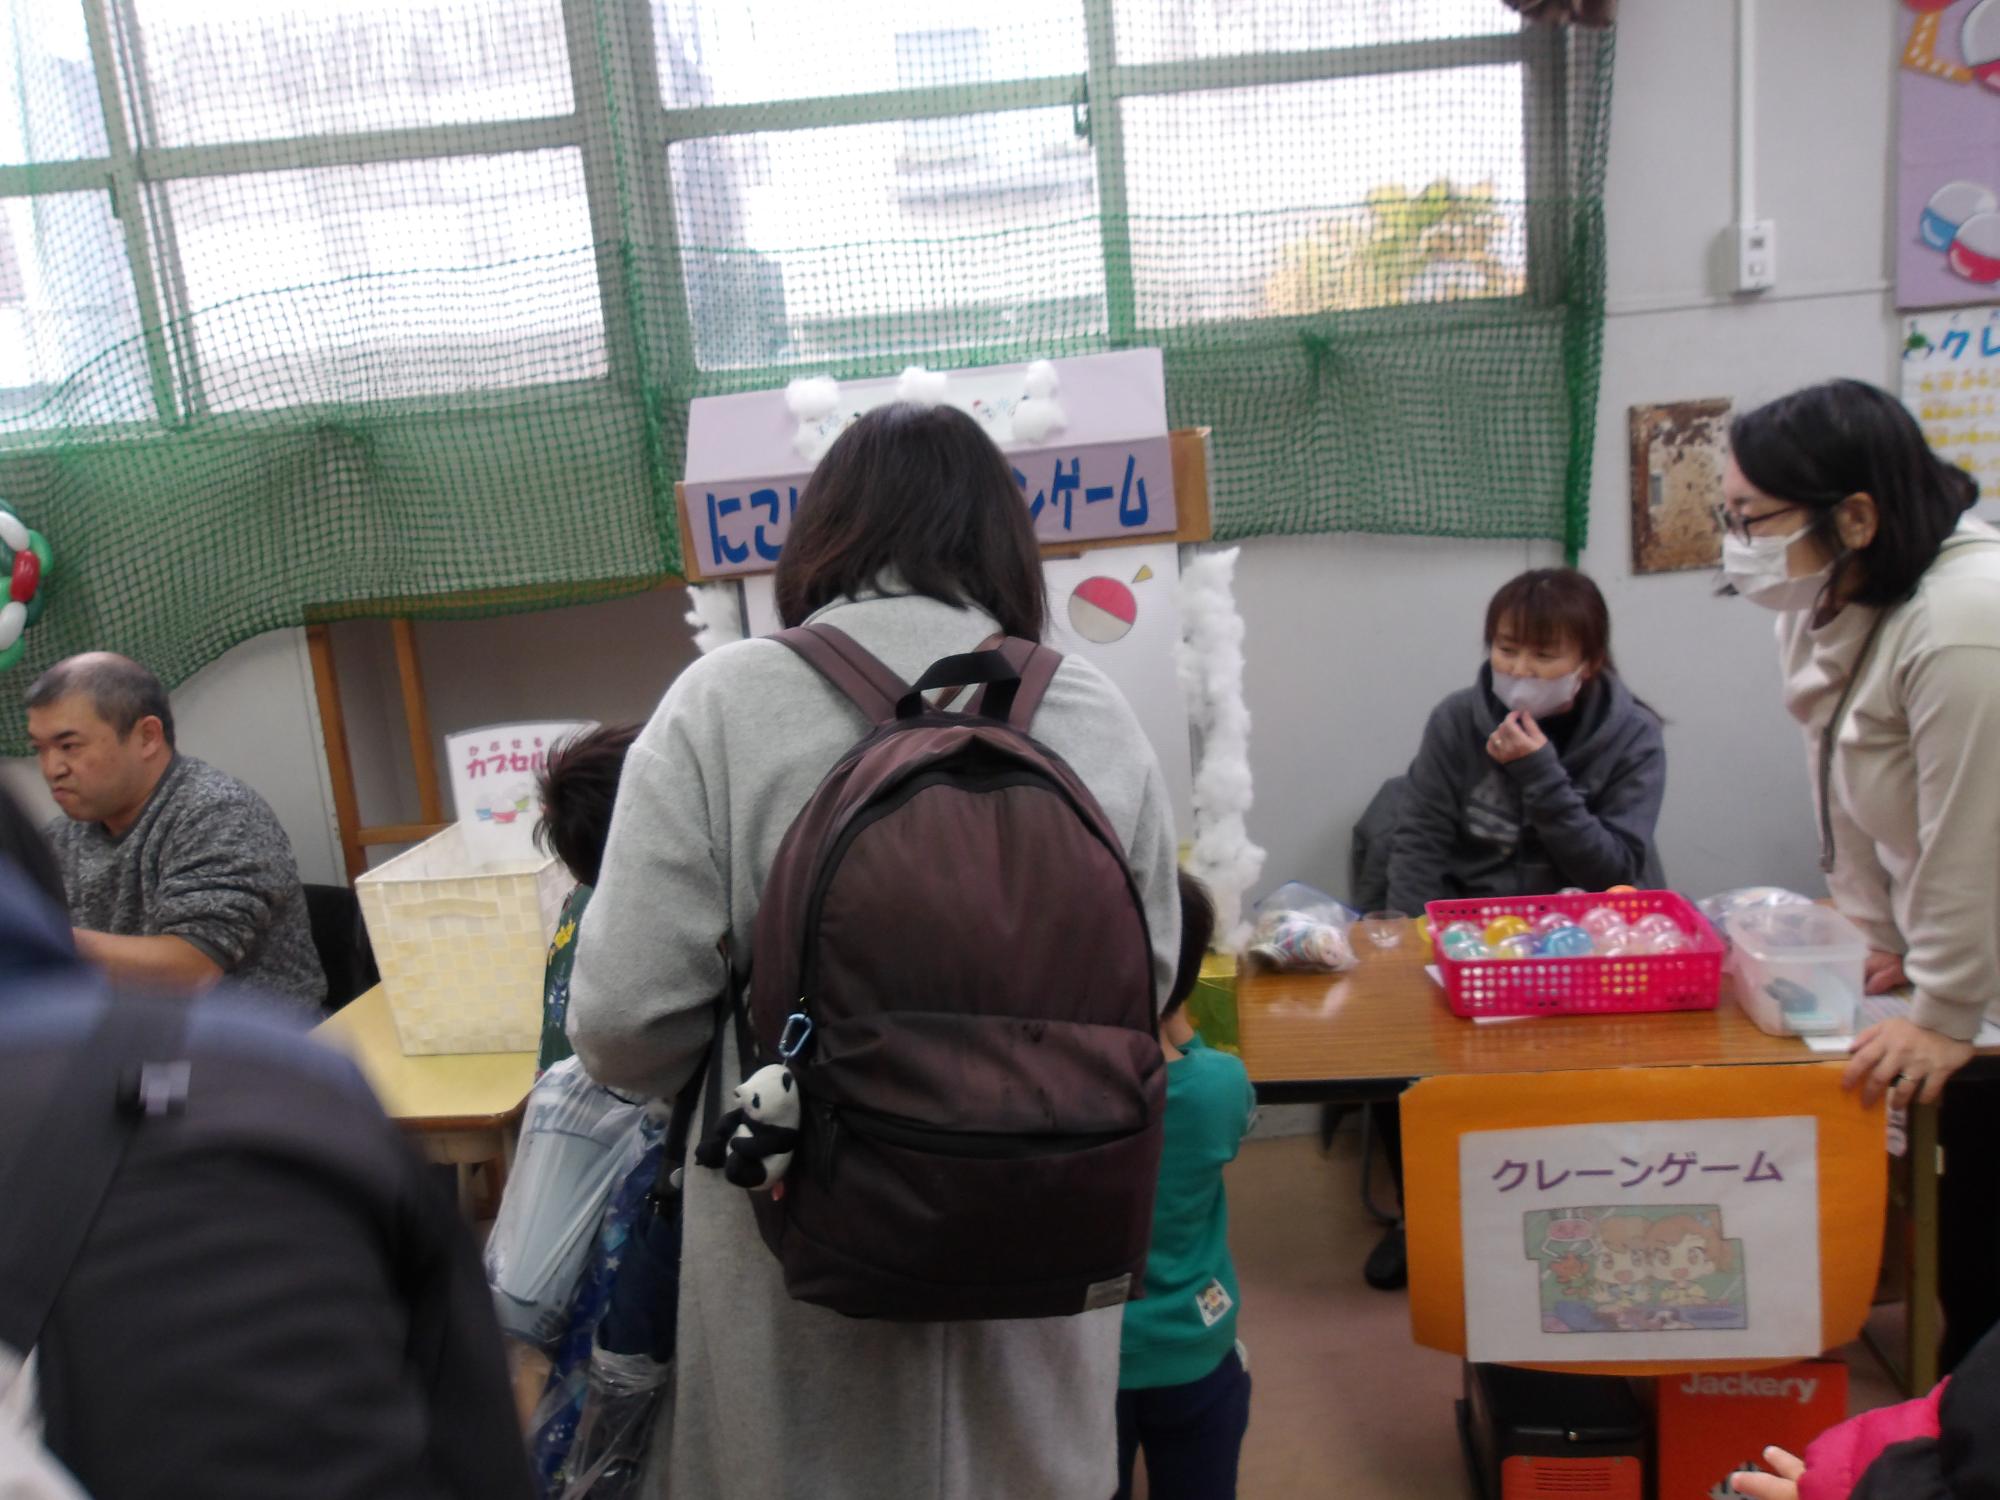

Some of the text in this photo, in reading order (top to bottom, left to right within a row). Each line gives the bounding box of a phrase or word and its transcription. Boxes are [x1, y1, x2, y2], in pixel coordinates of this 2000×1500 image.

[1492, 1151, 1783, 1192] クレーンゲーム
[1681, 1373, 1819, 1404] Jackery
